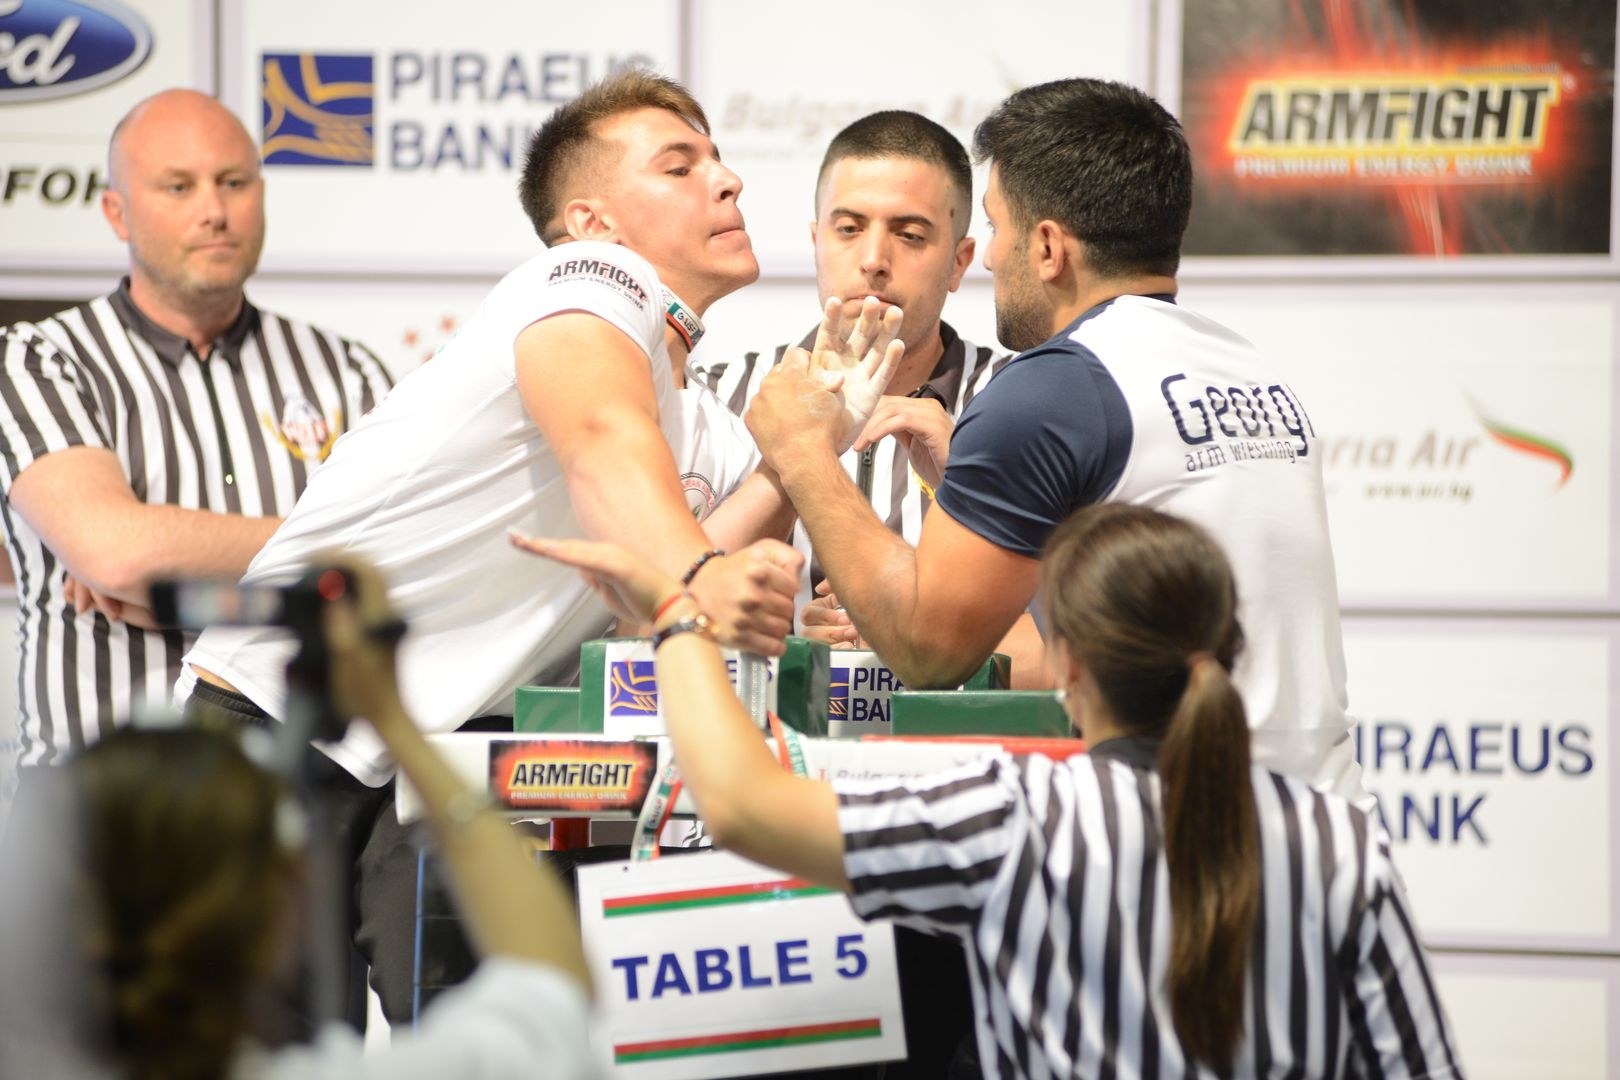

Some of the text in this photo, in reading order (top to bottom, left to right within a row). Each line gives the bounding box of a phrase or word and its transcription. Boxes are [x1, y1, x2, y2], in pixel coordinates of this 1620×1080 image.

[1242, 85, 1550, 141] ARMFIGHT
[391, 120, 535, 169] BAN
[549, 259, 647, 300] ARMFIGHT
[1185, 441, 1296, 471] arm wrestling
[1410, 429, 1481, 468] Air
[1355, 724, 1594, 776] IRAEUS
[513, 763, 633, 786] ARMFIGHT
[612, 934, 867, 1001] TABLE 5
